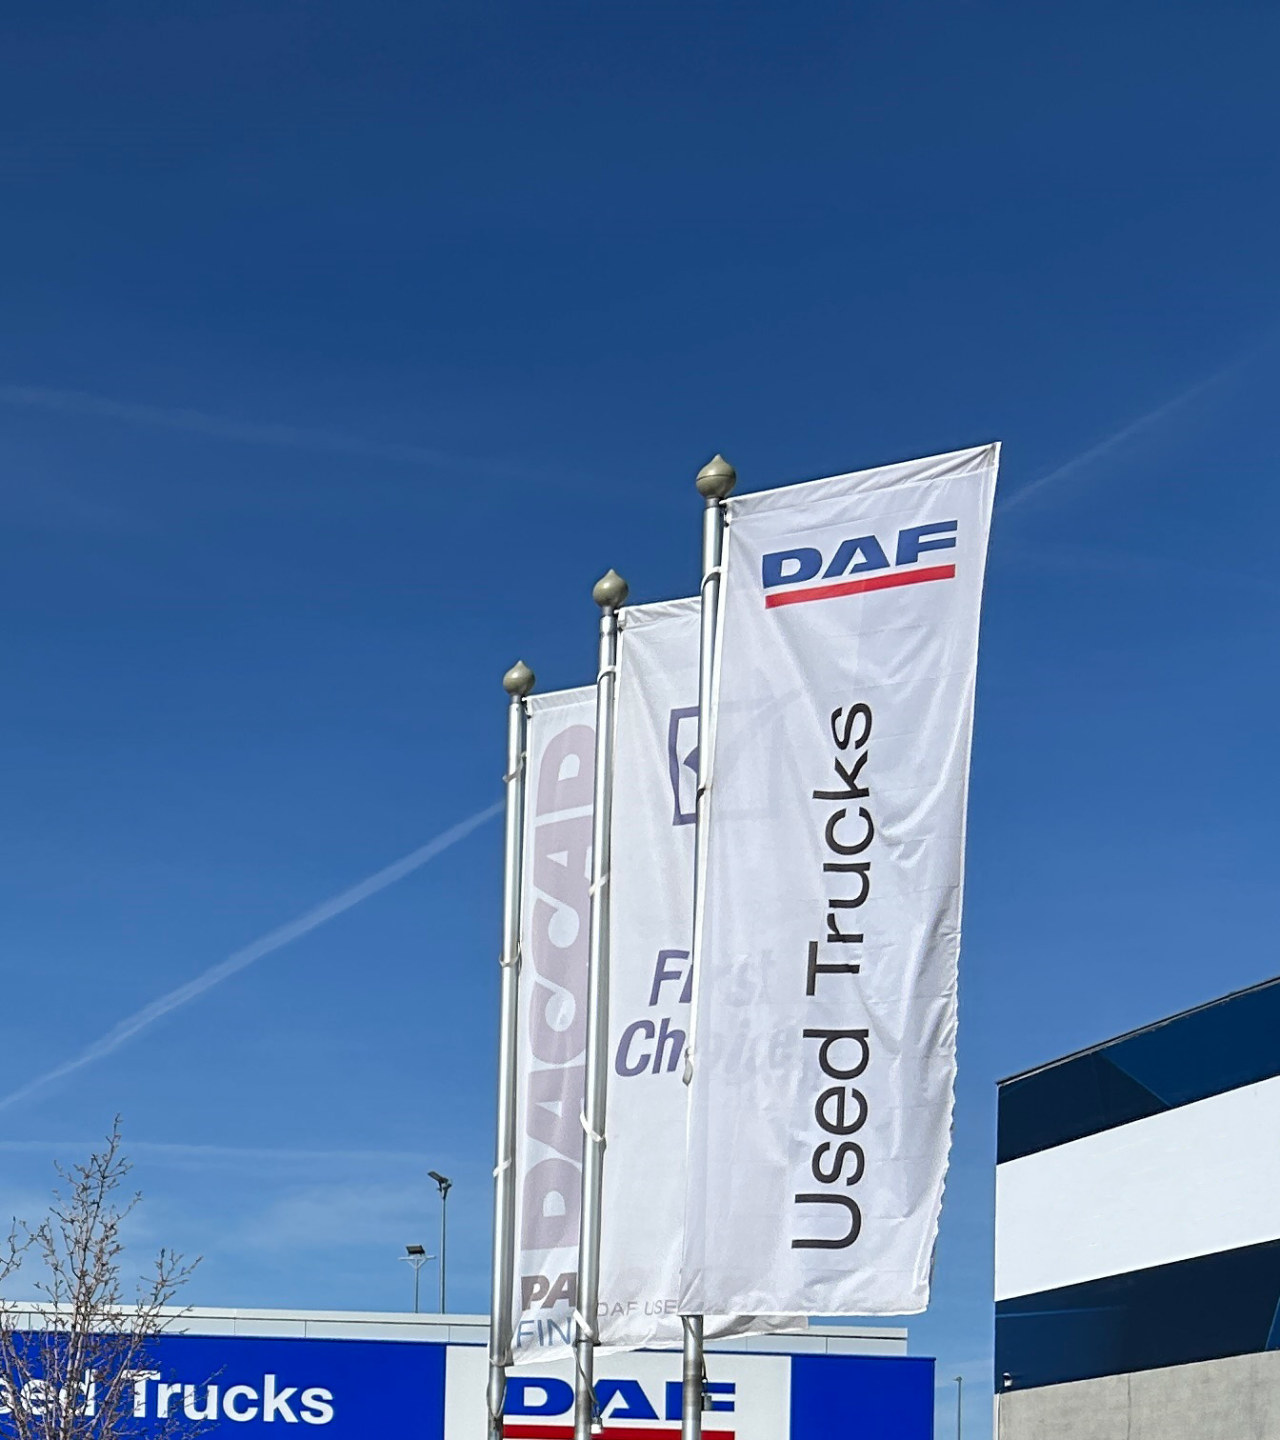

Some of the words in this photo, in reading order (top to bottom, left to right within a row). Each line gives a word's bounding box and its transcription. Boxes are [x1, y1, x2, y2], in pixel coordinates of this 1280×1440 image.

[762, 519, 958, 589] DAF
[806, 702, 875, 996] Trucks
[791, 1028, 870, 1249] Used
[120, 1368, 335, 1426] Trucks
